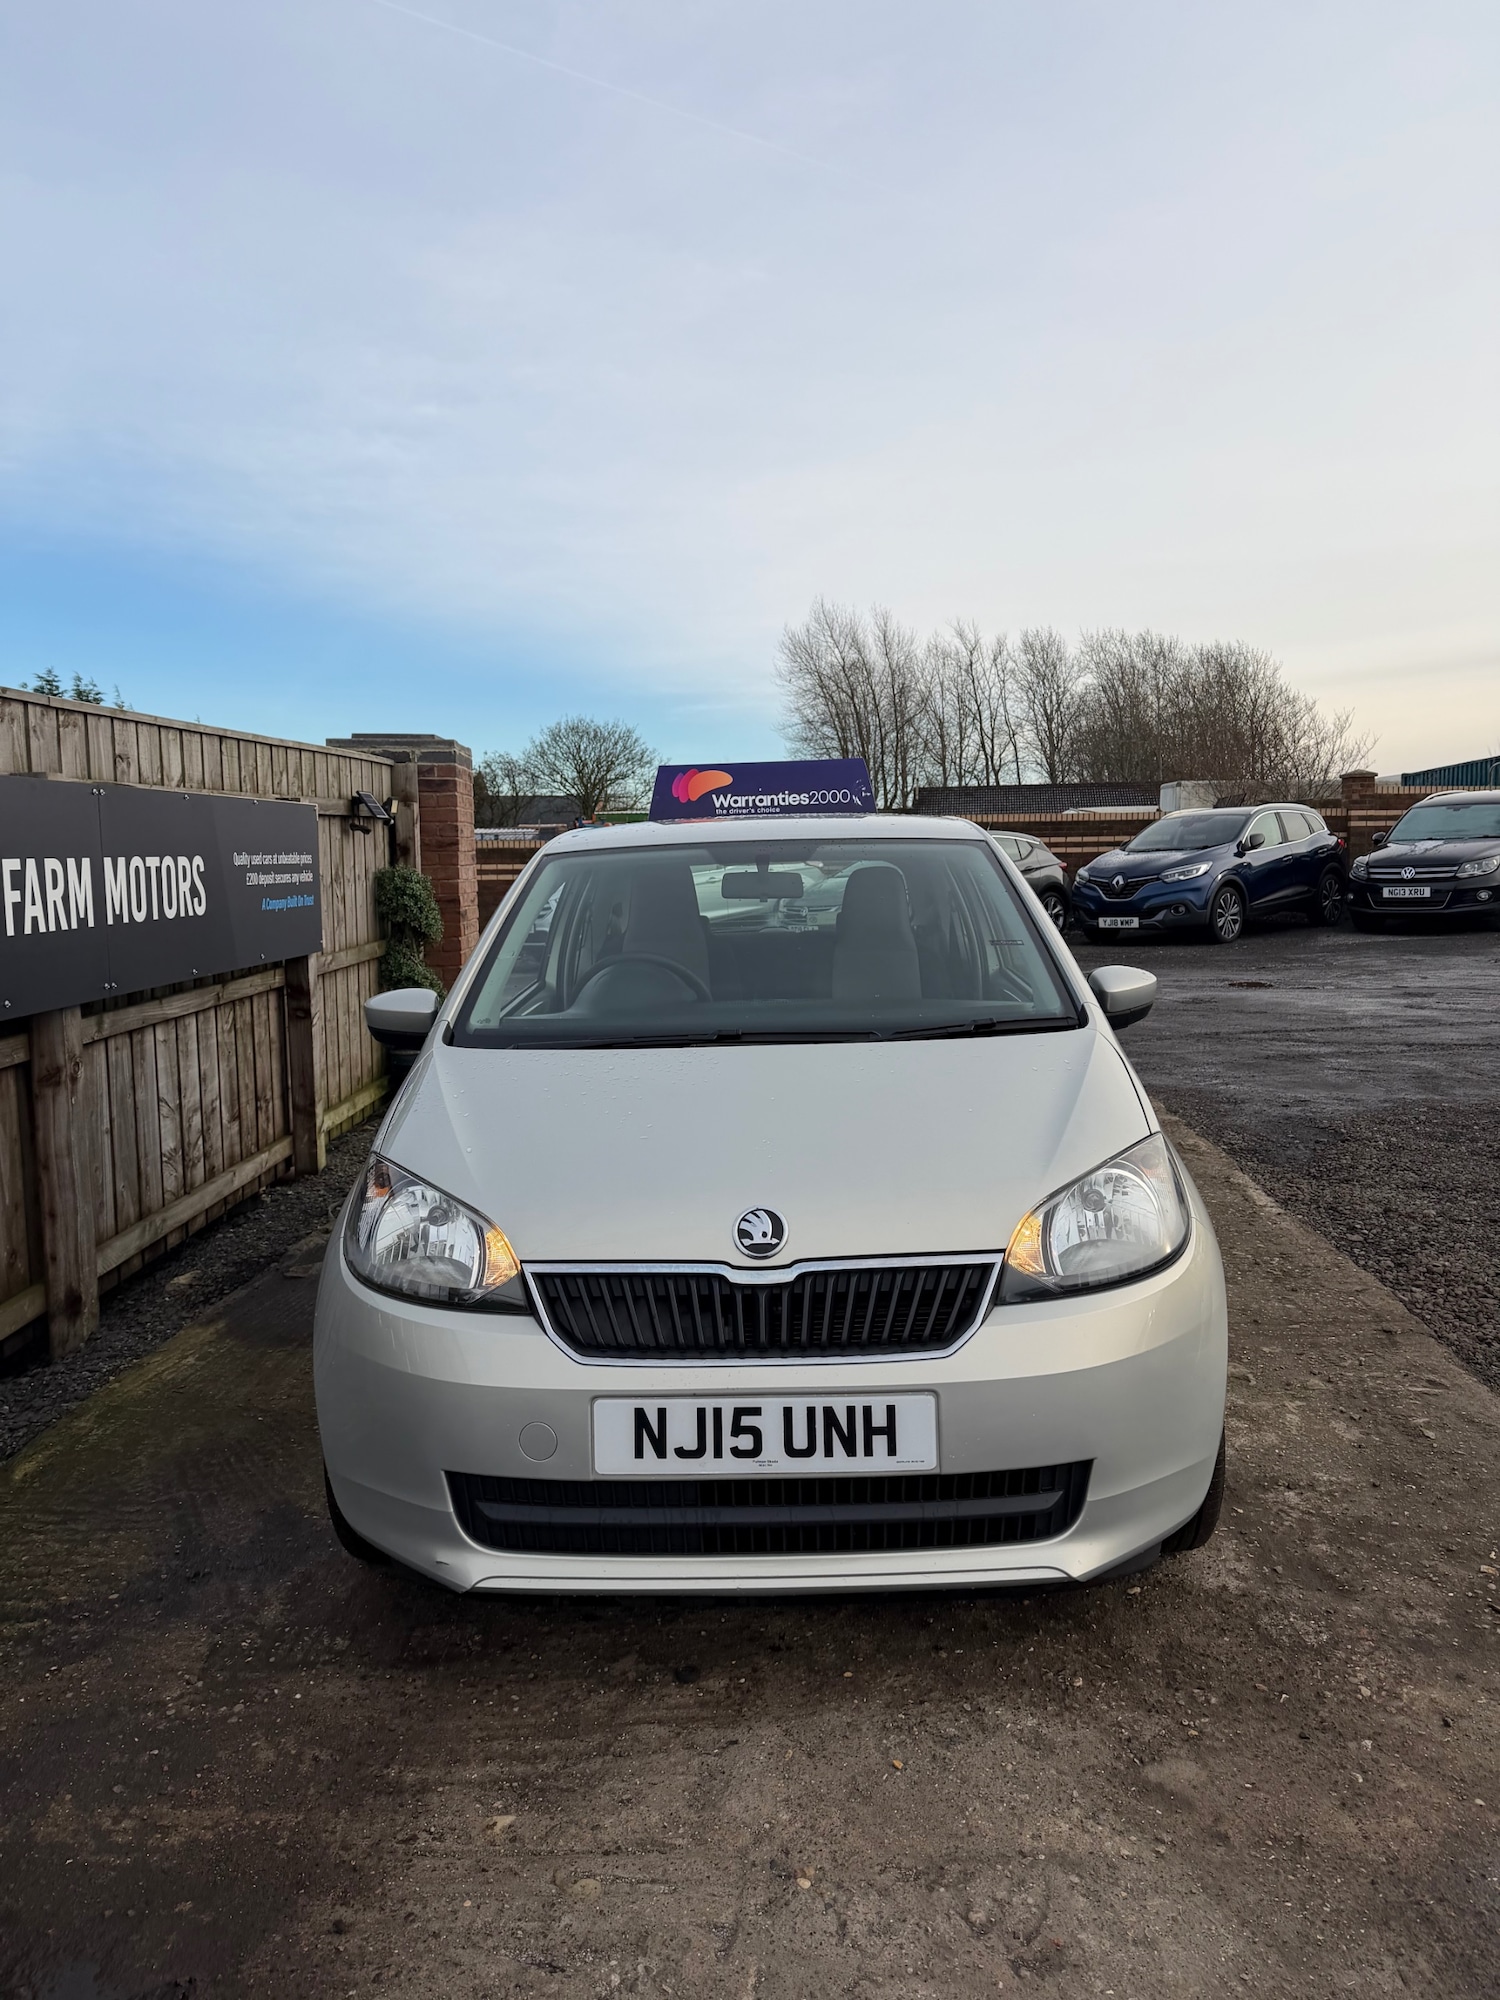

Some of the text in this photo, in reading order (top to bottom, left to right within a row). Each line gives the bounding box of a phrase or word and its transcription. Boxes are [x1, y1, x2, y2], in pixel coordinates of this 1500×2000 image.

[233, 852, 312, 868] Quality used cars at unbeatable prices
[246, 873, 258, 885] £200
[259, 871, 274, 887] deposit
[275, 874, 291, 884] secures
[300, 870, 313, 882] vehicle
[2, 855, 207, 936] FARM MOTORS
[1388, 888, 1425, 896] NG13 XRU
[266, 898, 286, 912] Company
[304, 895, 314, 906] Trust
[634, 1404, 896, 1459] NJ15 UNH
